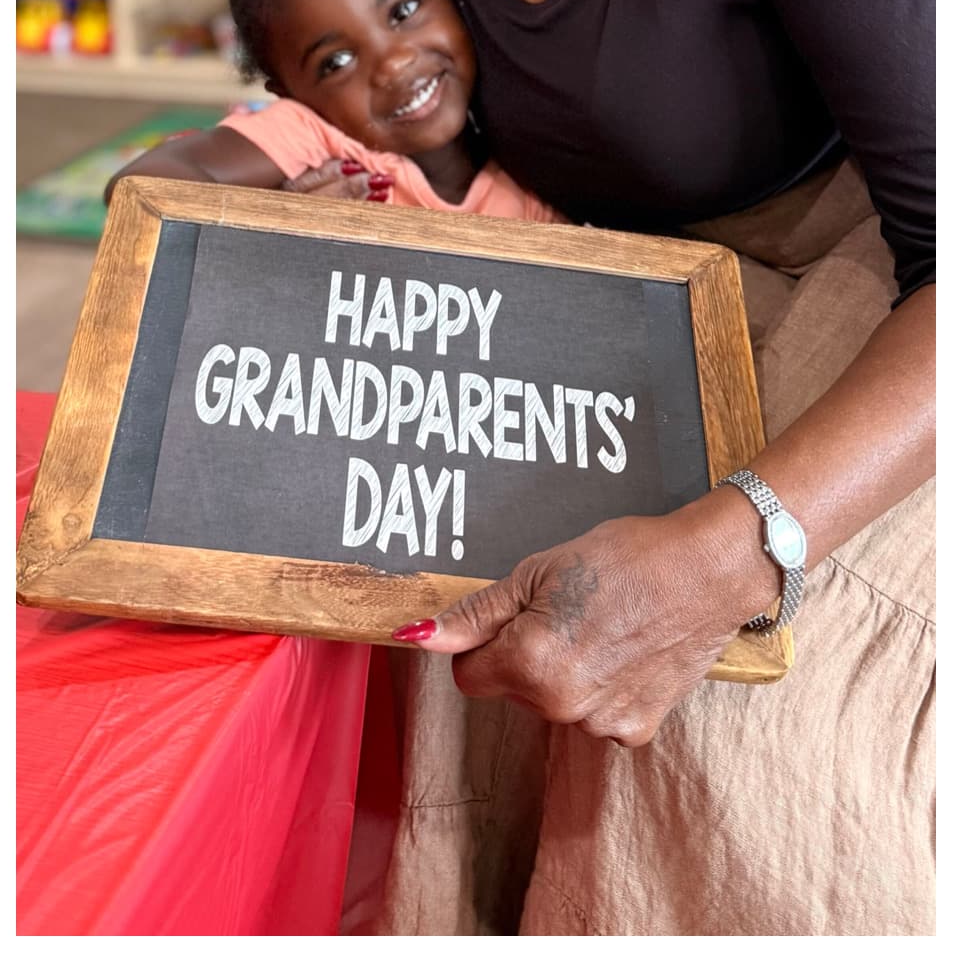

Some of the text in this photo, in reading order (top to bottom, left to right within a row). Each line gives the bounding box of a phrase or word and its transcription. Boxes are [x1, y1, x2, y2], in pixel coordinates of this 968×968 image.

[324, 270, 504, 362] HAPPY
[194, 343, 636, 474] GRANDPARENTS'
[341, 457, 467, 561] DAY!
